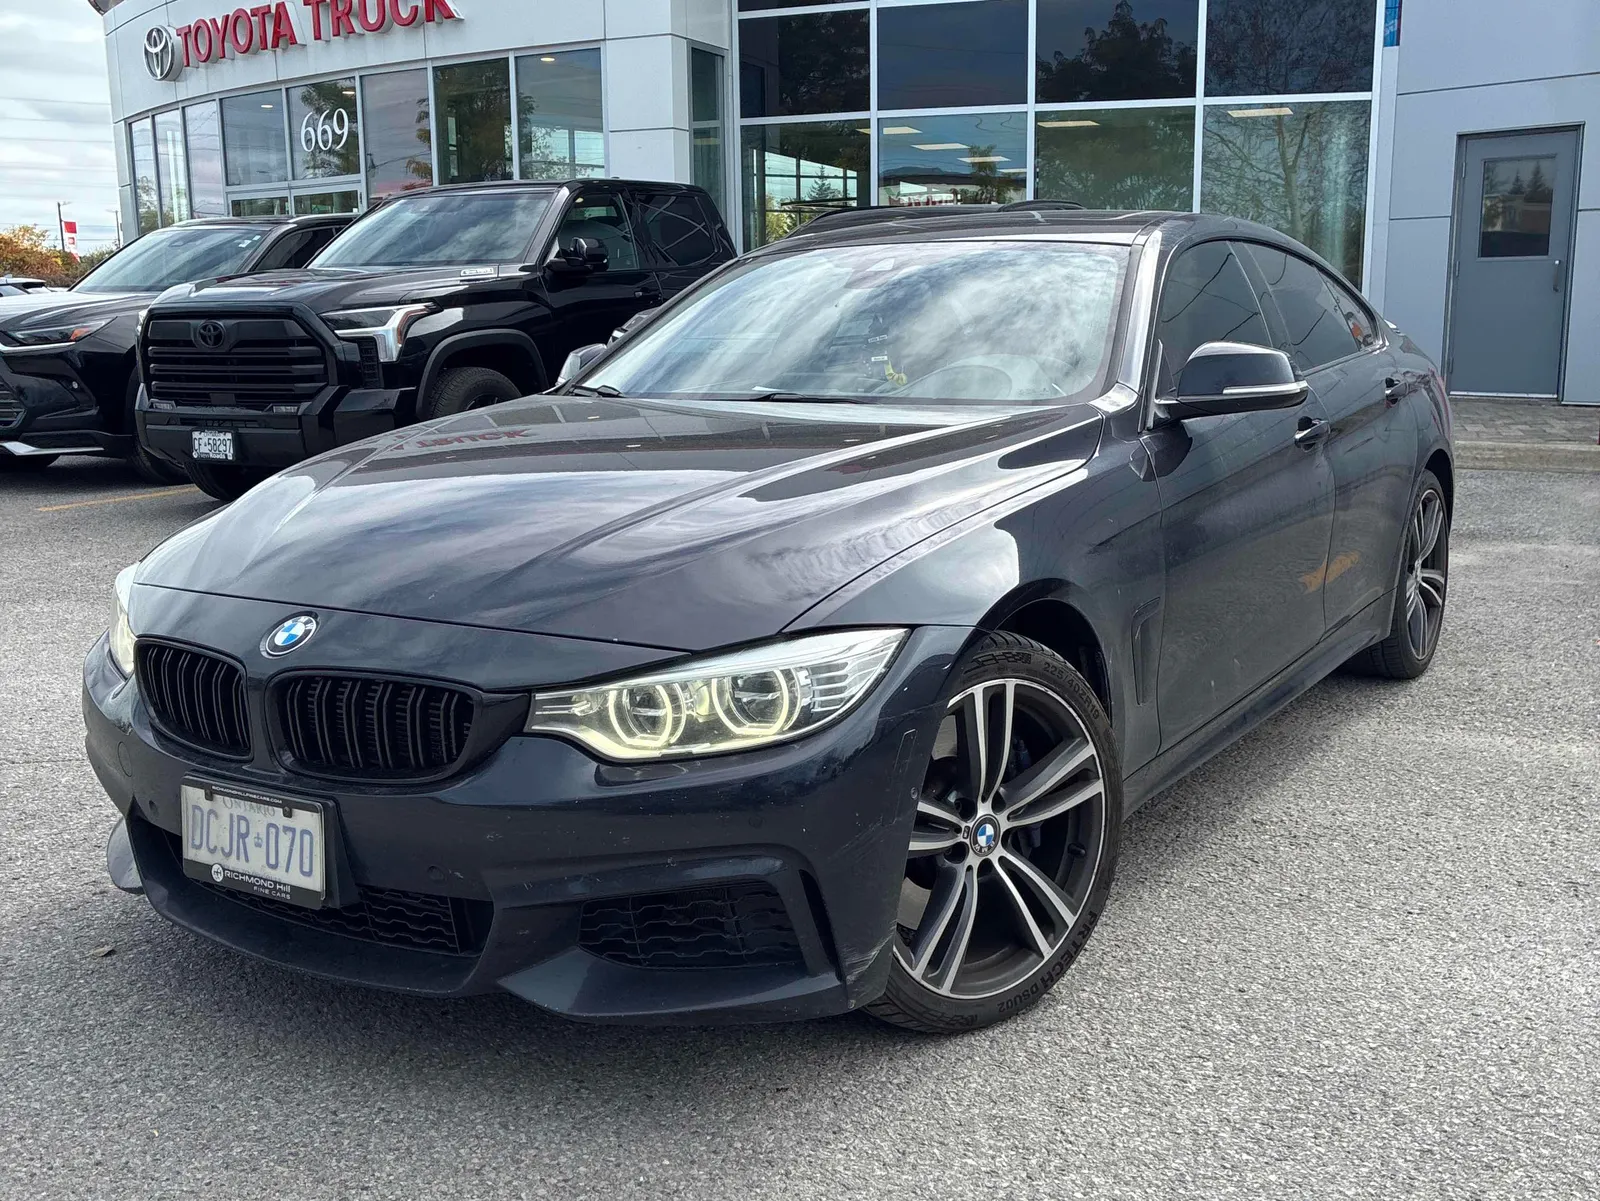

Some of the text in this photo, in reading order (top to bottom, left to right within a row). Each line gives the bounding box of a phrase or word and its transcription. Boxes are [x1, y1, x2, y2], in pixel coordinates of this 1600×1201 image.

[176, 2, 300, 67] TOYOTA
[301, 108, 349, 152] 669
[207, 437, 232, 453] 58297
[191, 804, 314, 877] DCJR 070
[224, 870, 275, 889] RICHMOND
[253, 885, 291, 900] FINE CARS
